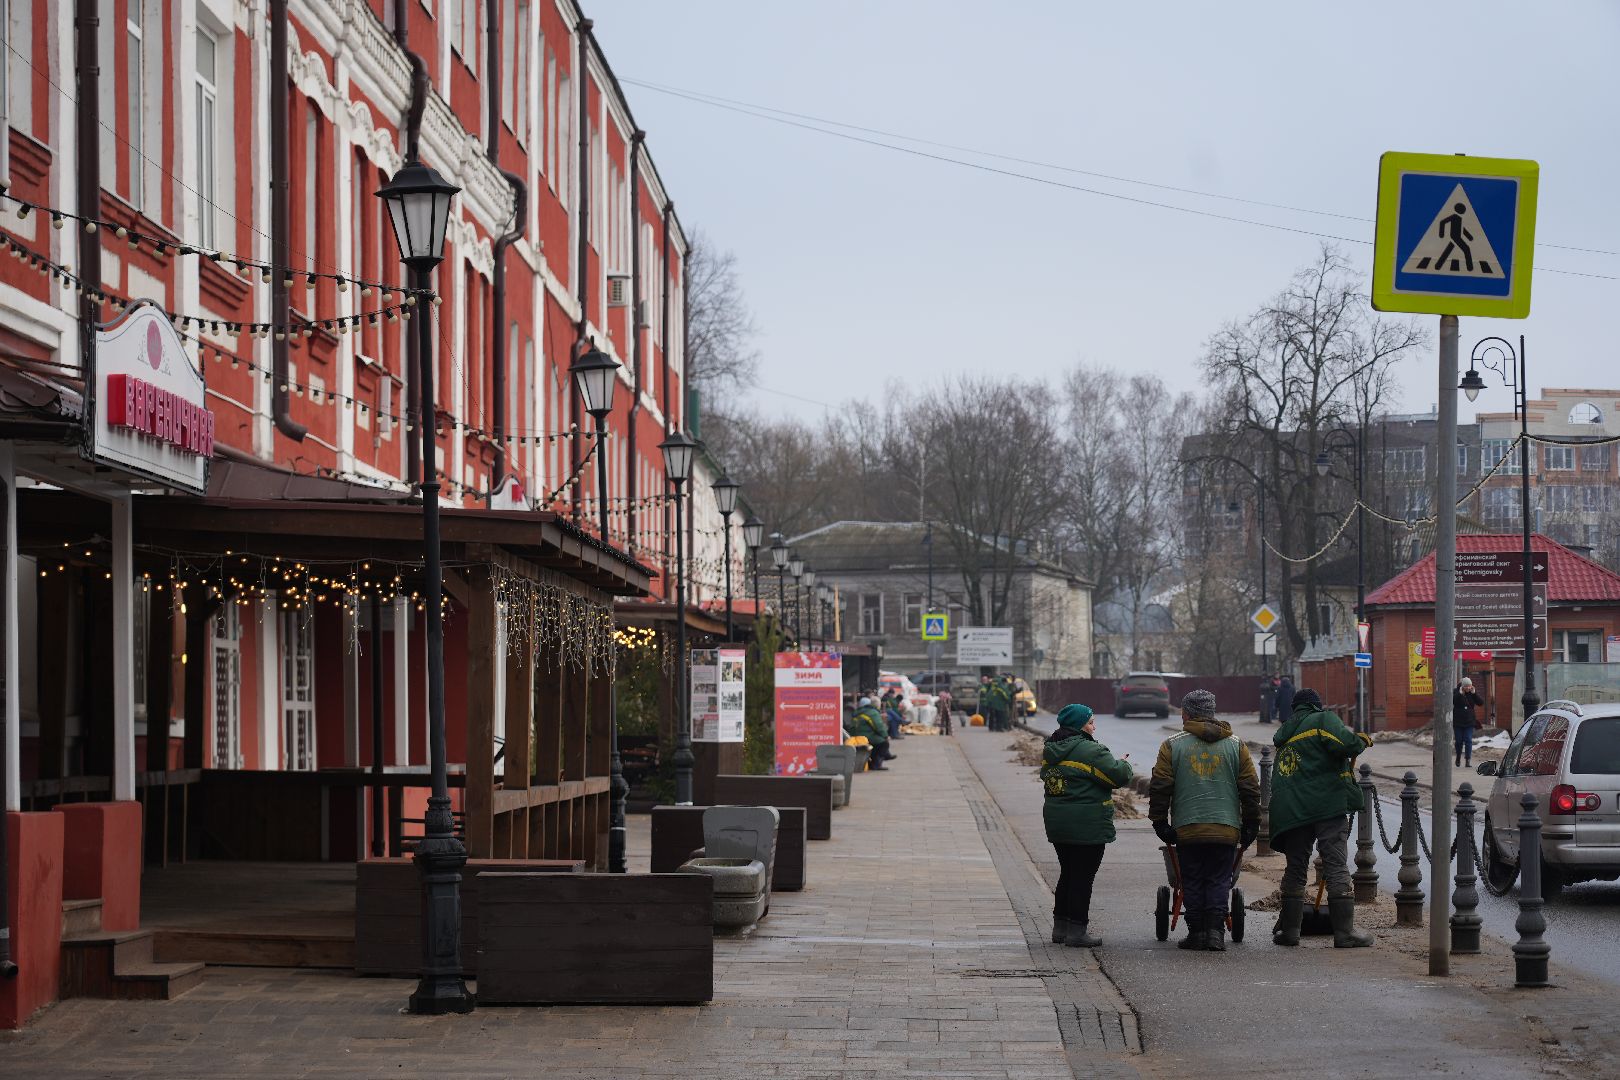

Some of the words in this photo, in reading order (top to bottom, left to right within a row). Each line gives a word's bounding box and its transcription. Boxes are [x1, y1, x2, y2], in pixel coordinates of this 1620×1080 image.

[118, 373, 215, 458] ВАРЕНИЧНАЯ
[1463, 569, 1503, 577] Chernigovsky
[794, 671, 822, 679] ЗИМА
[815, 702, 836, 710] ЭТАЖ
